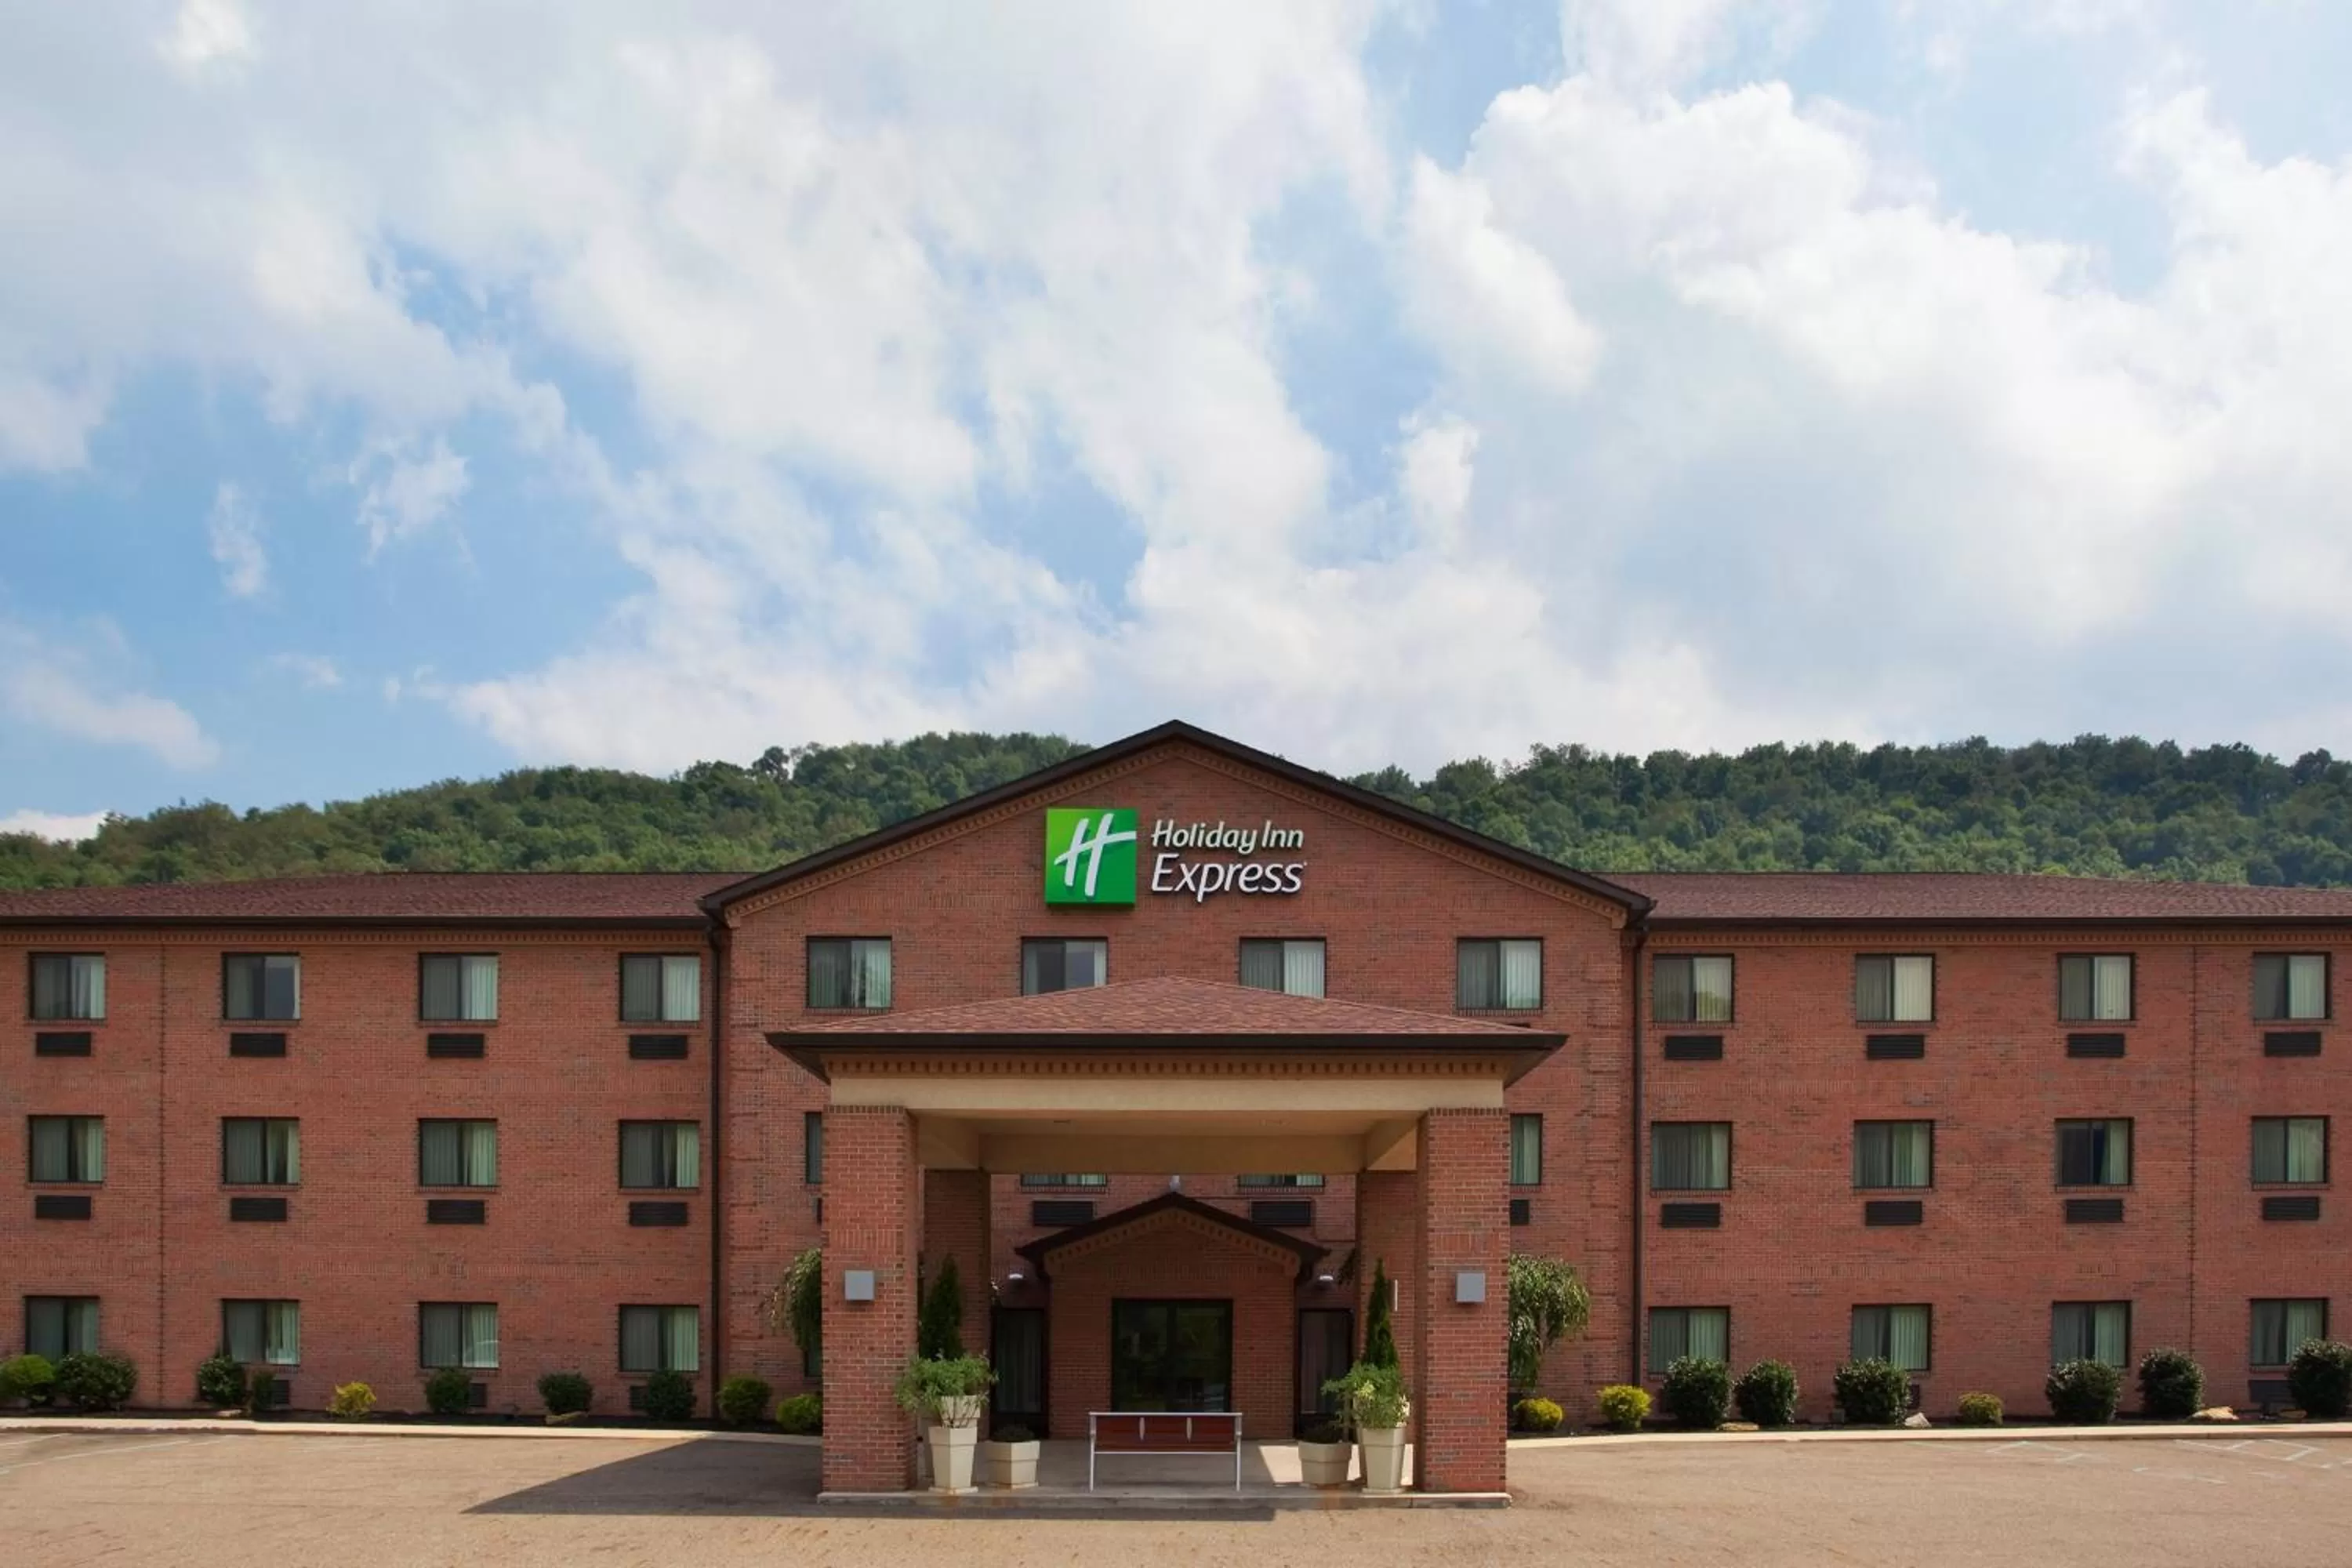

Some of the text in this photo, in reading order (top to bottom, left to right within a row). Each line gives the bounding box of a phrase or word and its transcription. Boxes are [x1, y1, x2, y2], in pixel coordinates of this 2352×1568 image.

[1054, 813, 1137, 897] H
[1151, 819, 1304, 854] Holiday Inn
[1151, 853, 1304, 902] Express
